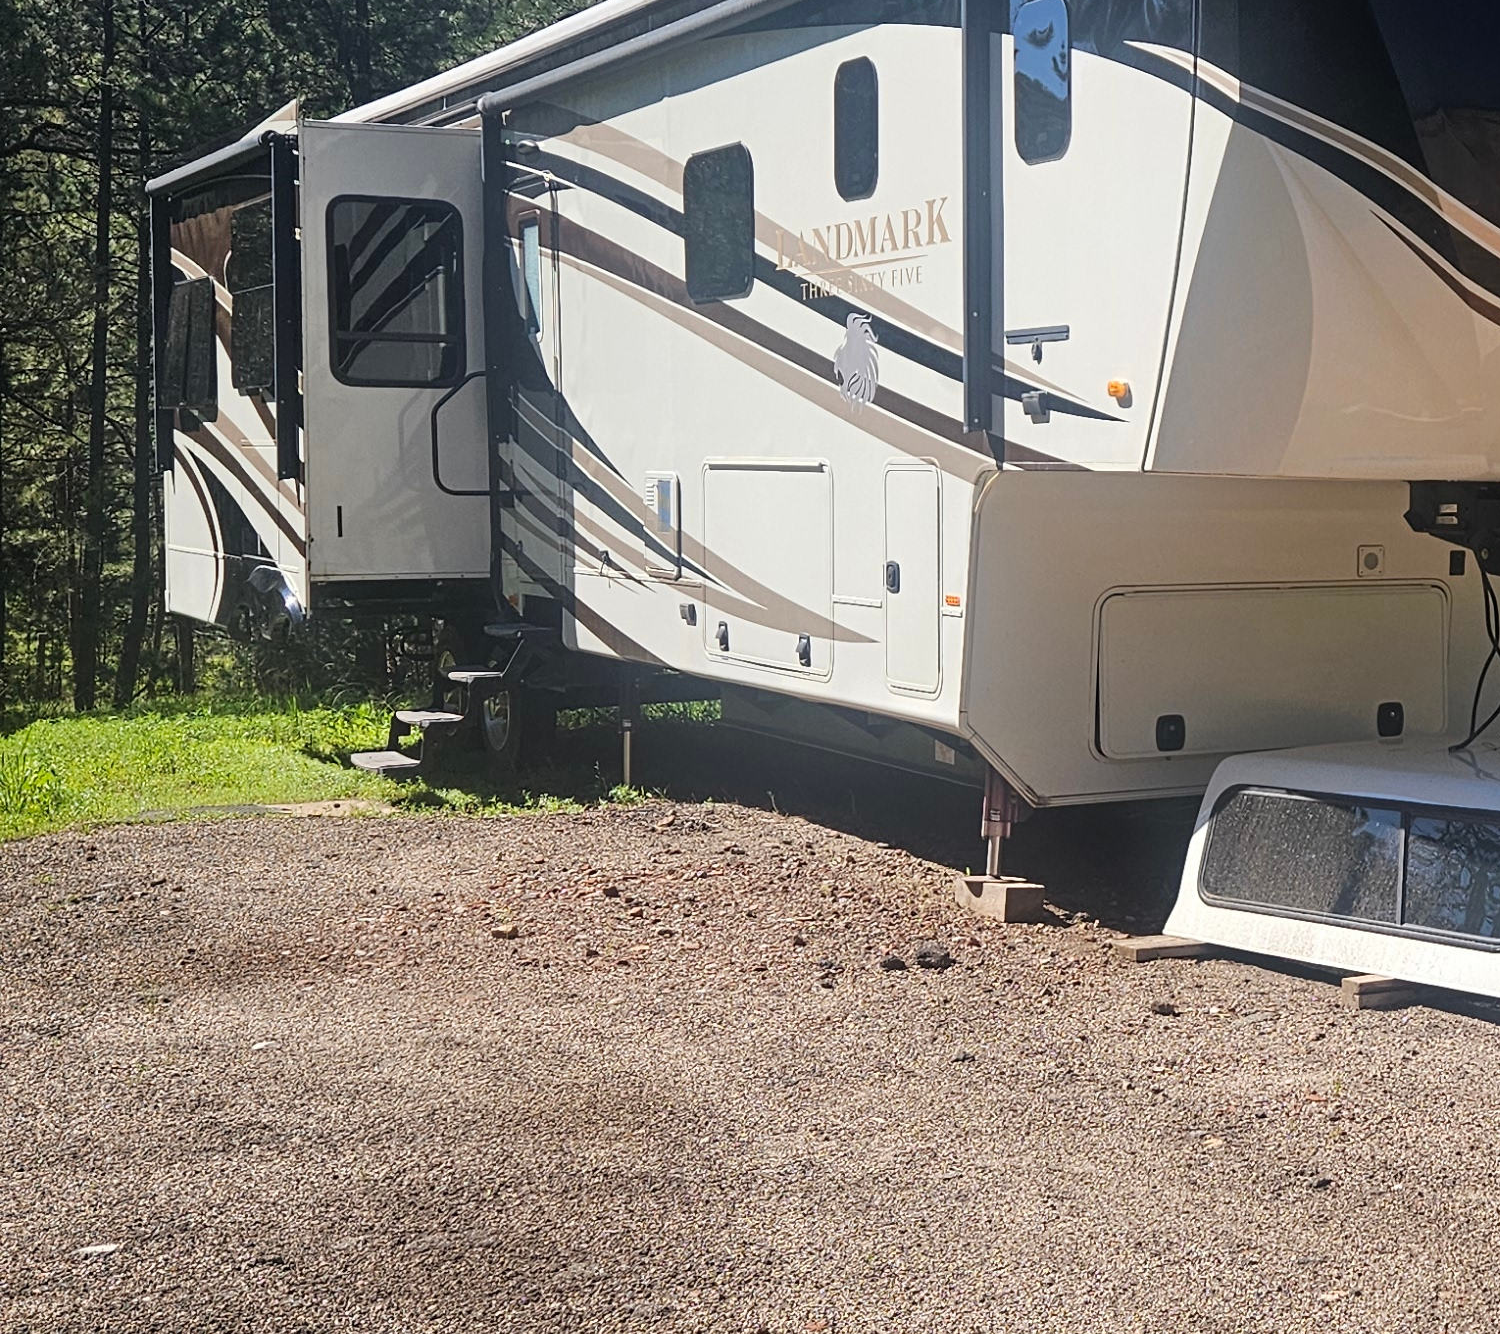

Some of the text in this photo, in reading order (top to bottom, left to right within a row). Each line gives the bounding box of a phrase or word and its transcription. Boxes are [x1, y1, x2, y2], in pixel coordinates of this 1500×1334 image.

[775, 196, 953, 271] LANDMARK
[800, 265, 923, 301] THREE SIXTY FIVE
